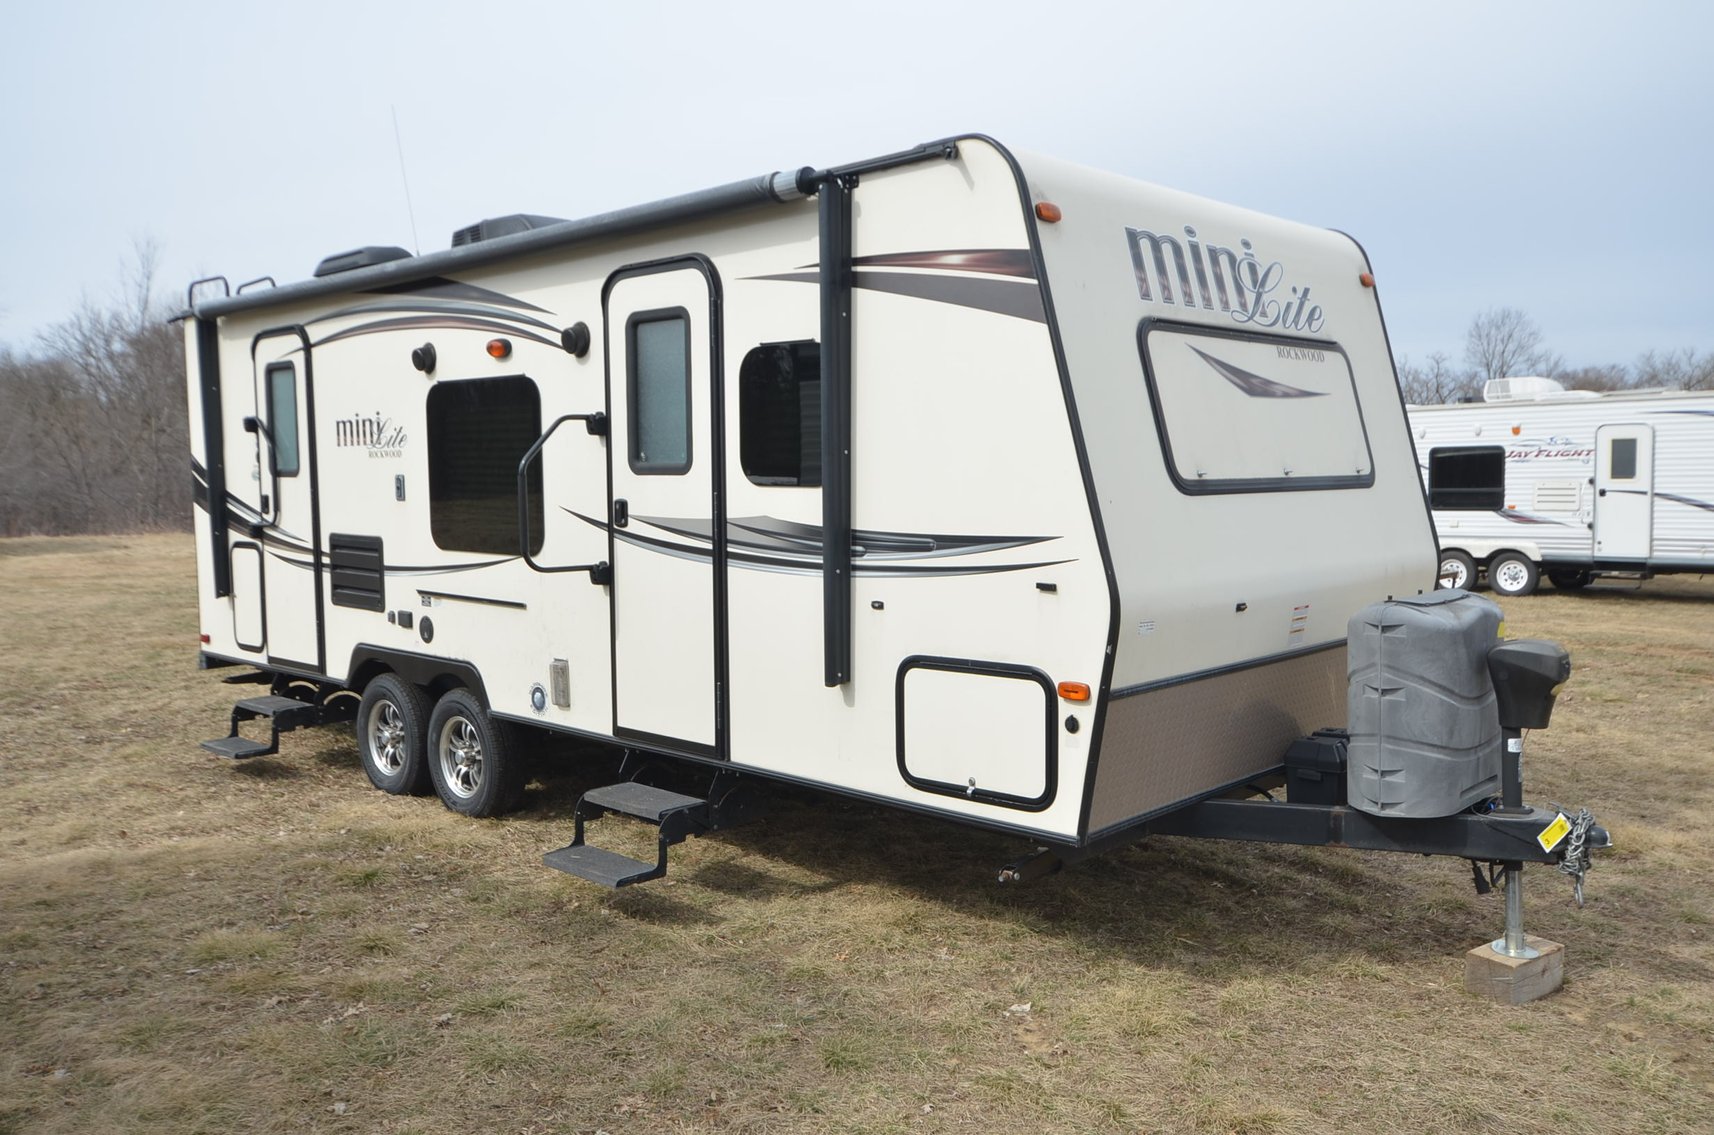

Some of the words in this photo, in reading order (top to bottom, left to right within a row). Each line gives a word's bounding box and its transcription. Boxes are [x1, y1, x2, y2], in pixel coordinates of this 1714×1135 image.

[1125, 225, 1268, 318] mini
[1230, 261, 1325, 334] Lite
[1276, 346, 1325, 362] ROCKWOOD
[336, 411, 381, 447] mini
[366, 417, 408, 450] Lite
[1505, 450, 1533, 459] JAY
[1534, 449, 1595, 458] FLIGHT
